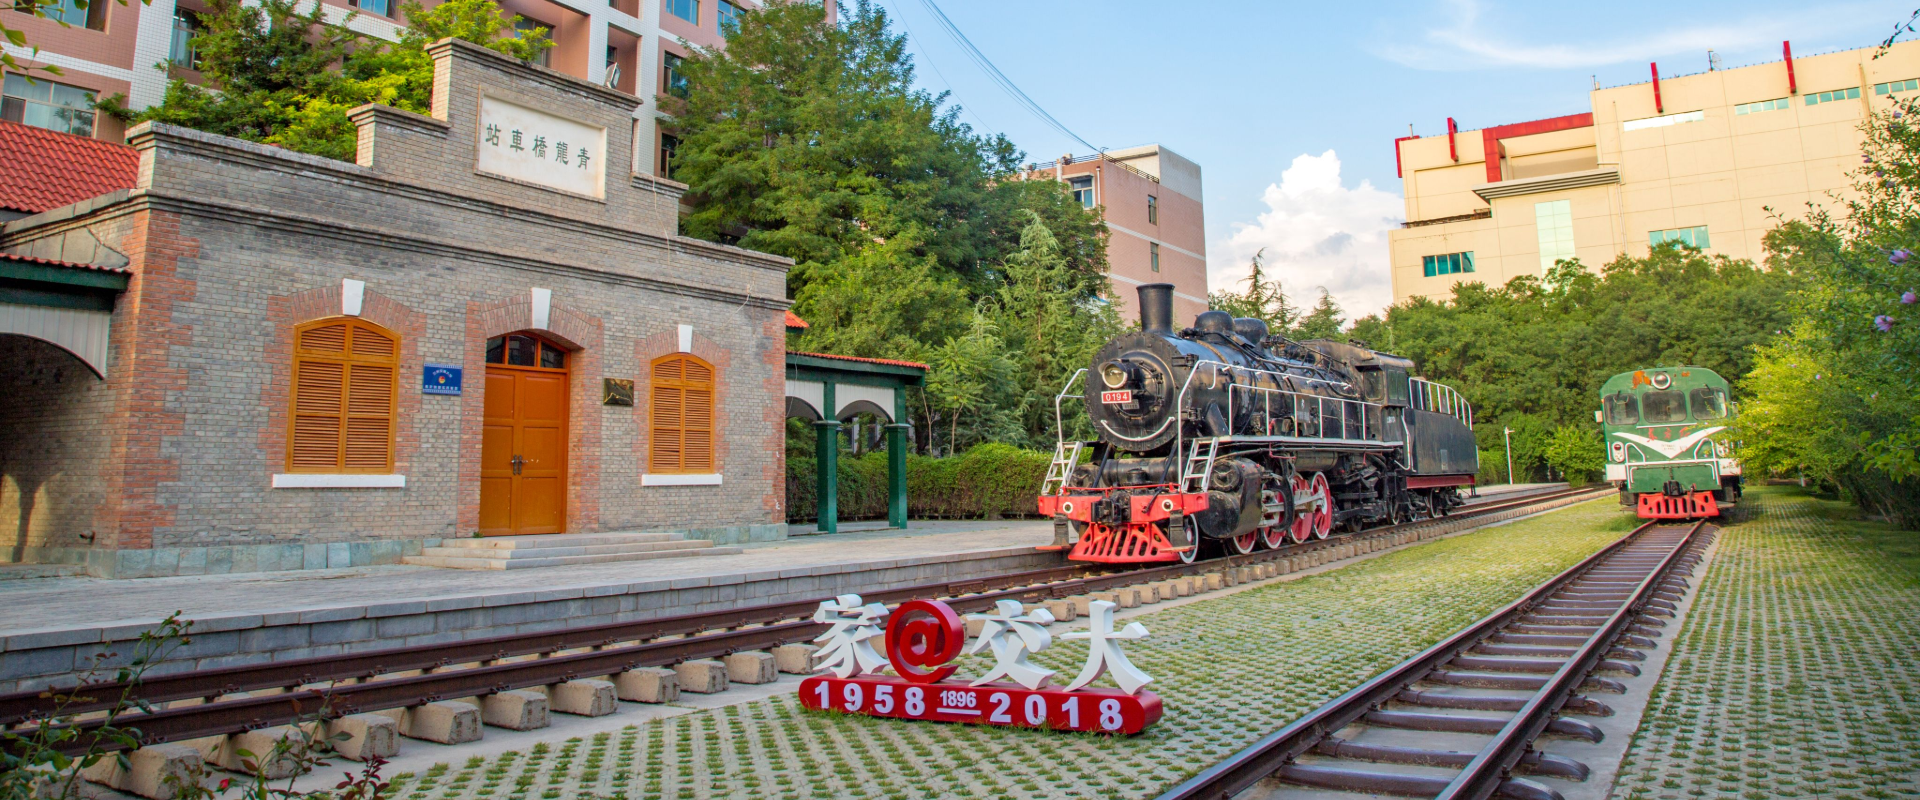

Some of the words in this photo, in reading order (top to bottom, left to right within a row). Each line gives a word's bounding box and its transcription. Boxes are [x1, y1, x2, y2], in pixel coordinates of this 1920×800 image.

[1105, 393, 1127, 402] 0194
[814, 681, 926, 716] 1958
[939, 690, 977, 708] 1896
[989, 692, 1124, 731] 2018
